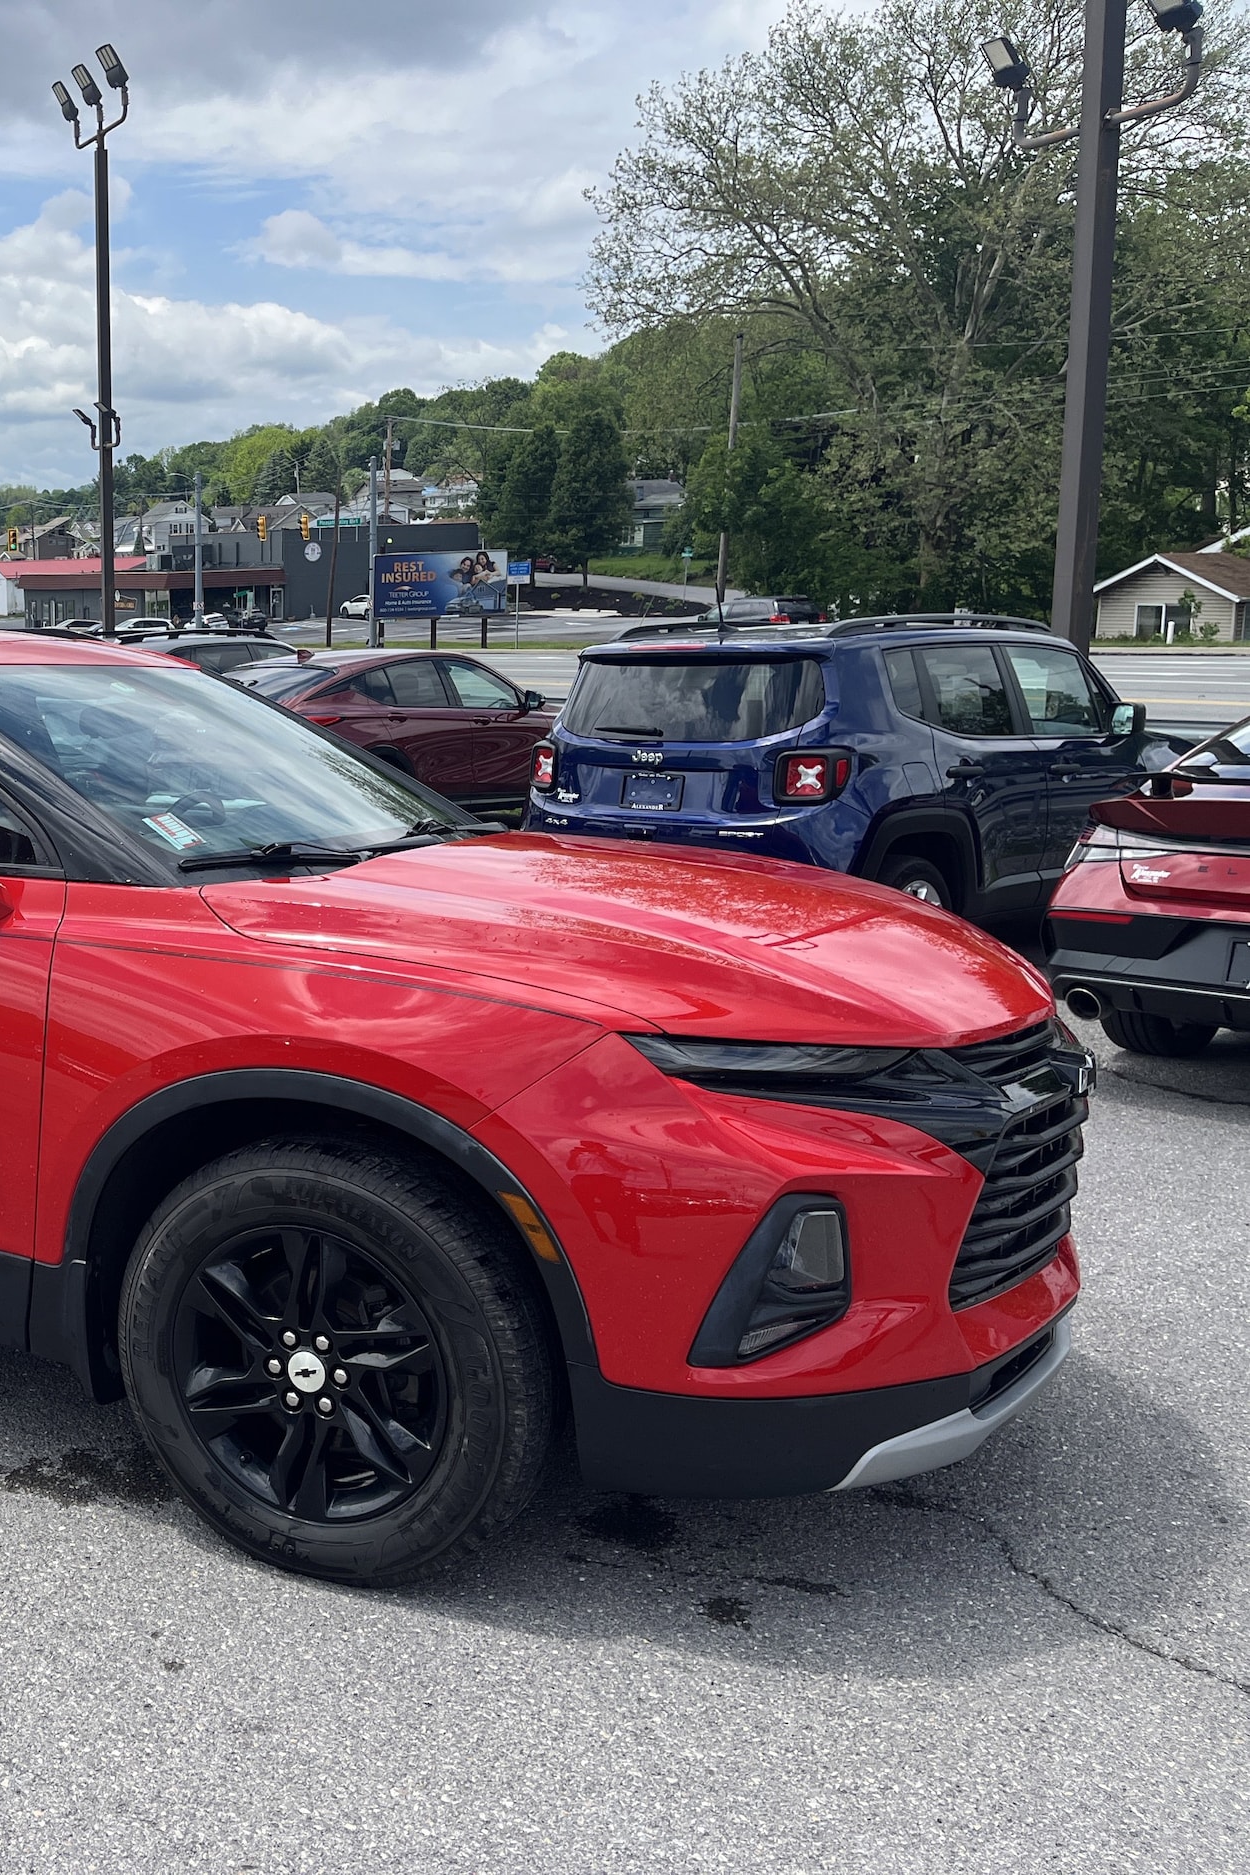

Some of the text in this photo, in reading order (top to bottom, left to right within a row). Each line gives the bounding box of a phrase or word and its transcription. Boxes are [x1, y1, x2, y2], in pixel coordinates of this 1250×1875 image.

[393, 561, 425, 572] REST
[381, 571, 437, 583] INSURED
[632, 750, 663, 765] Jeep
[631, 802, 664, 810] ALEXANDER
[718, 830, 764, 838] SPORT
